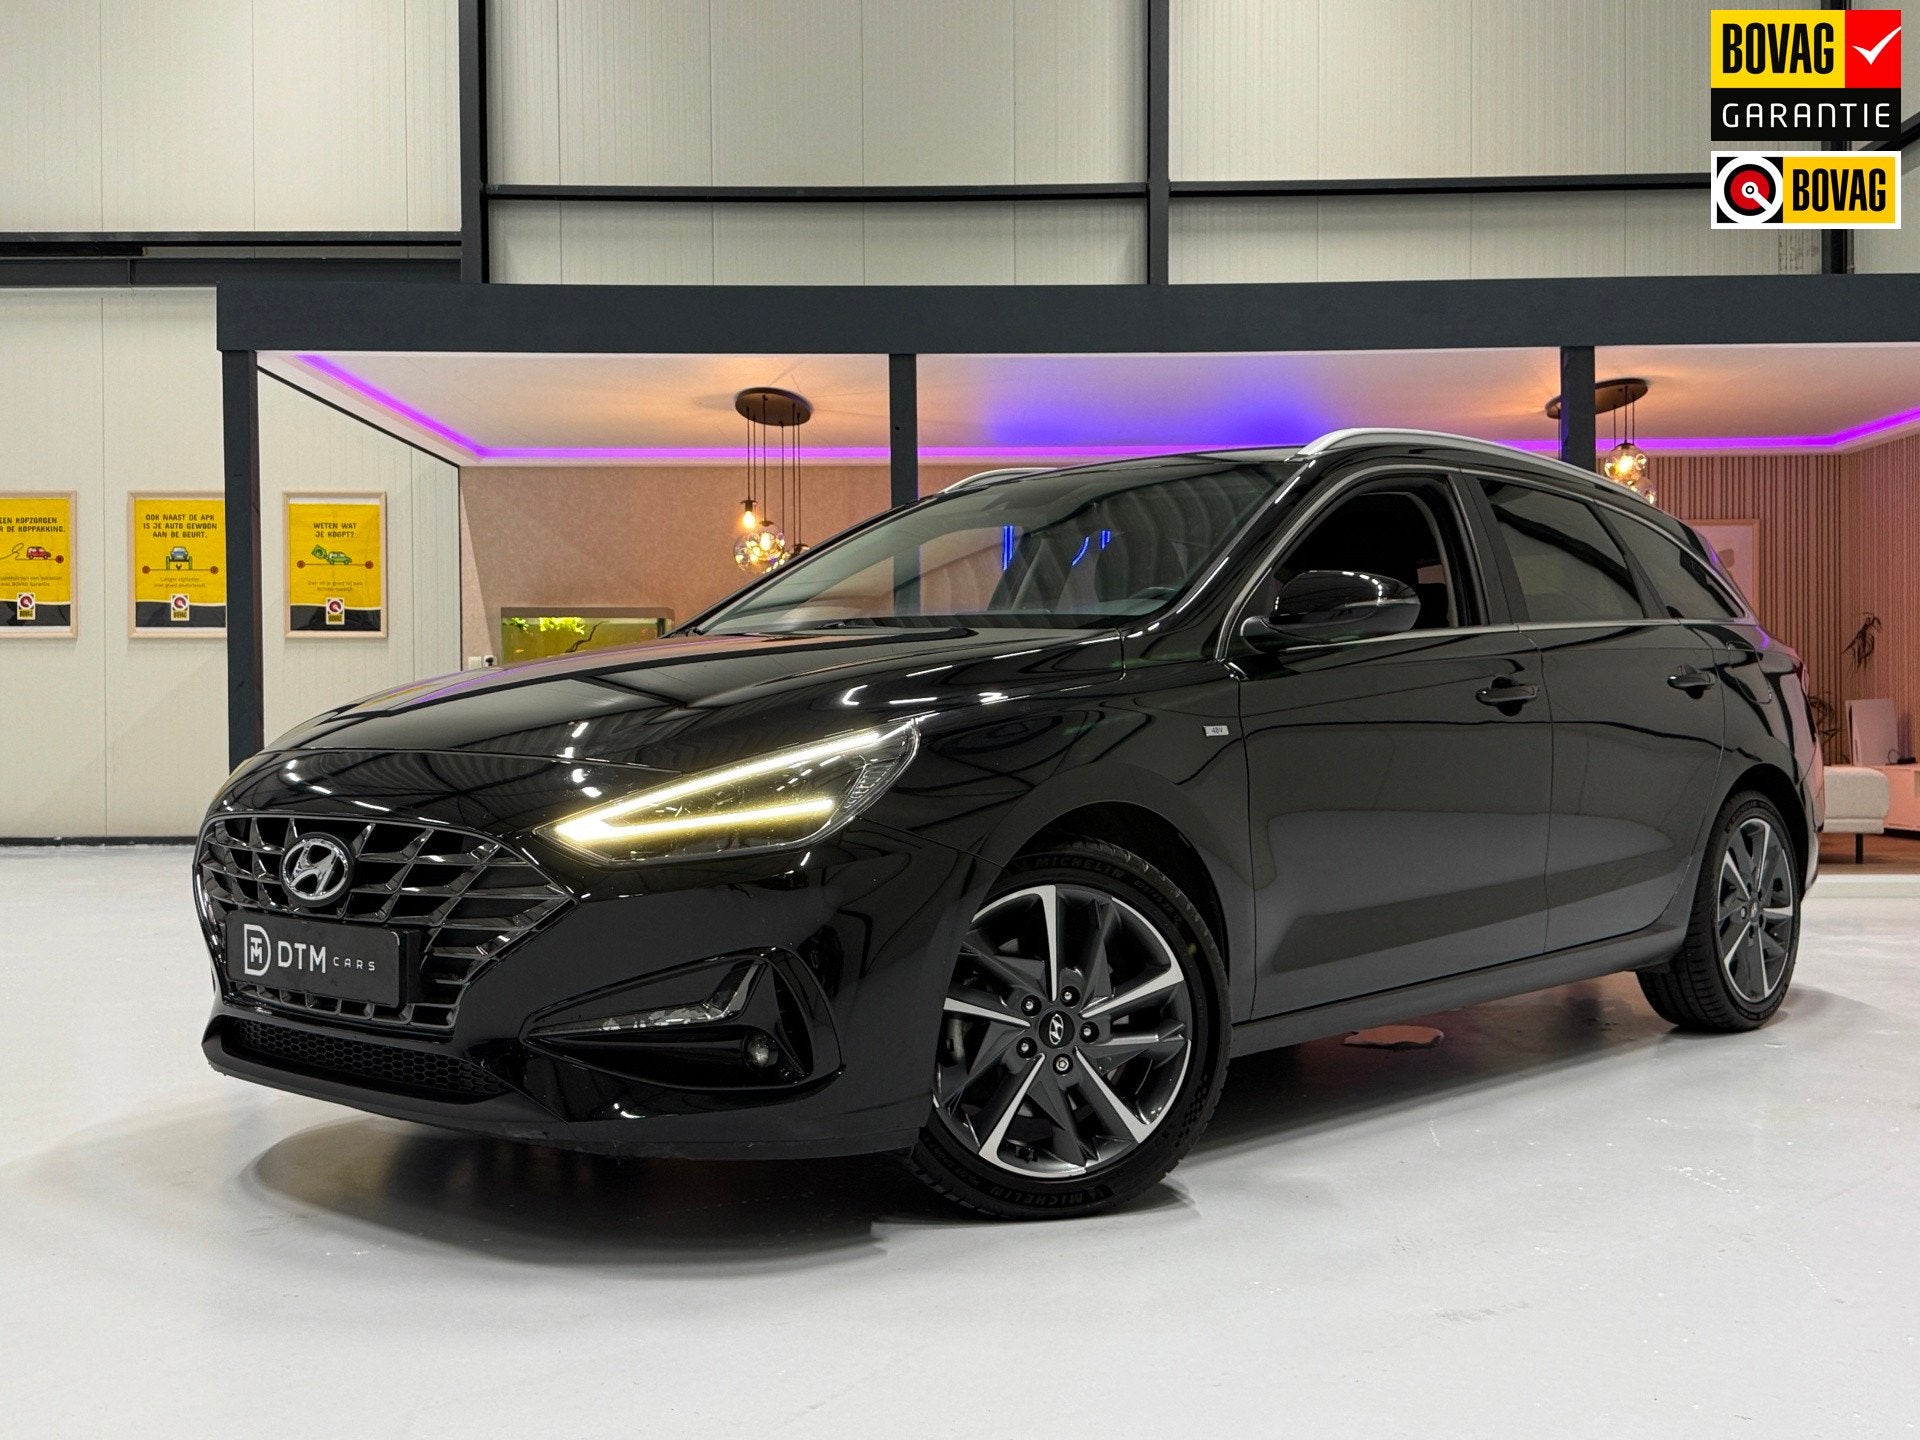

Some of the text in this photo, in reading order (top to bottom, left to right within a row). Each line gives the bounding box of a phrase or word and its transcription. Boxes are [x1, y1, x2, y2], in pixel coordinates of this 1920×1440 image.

[18, 525, 66, 533] KOPPAKKING.
[1035, 856, 1127, 879] MICHELIN
[277, 940, 376, 974] DTM CARS
[989, 1185, 1085, 1206] MICHELIN
